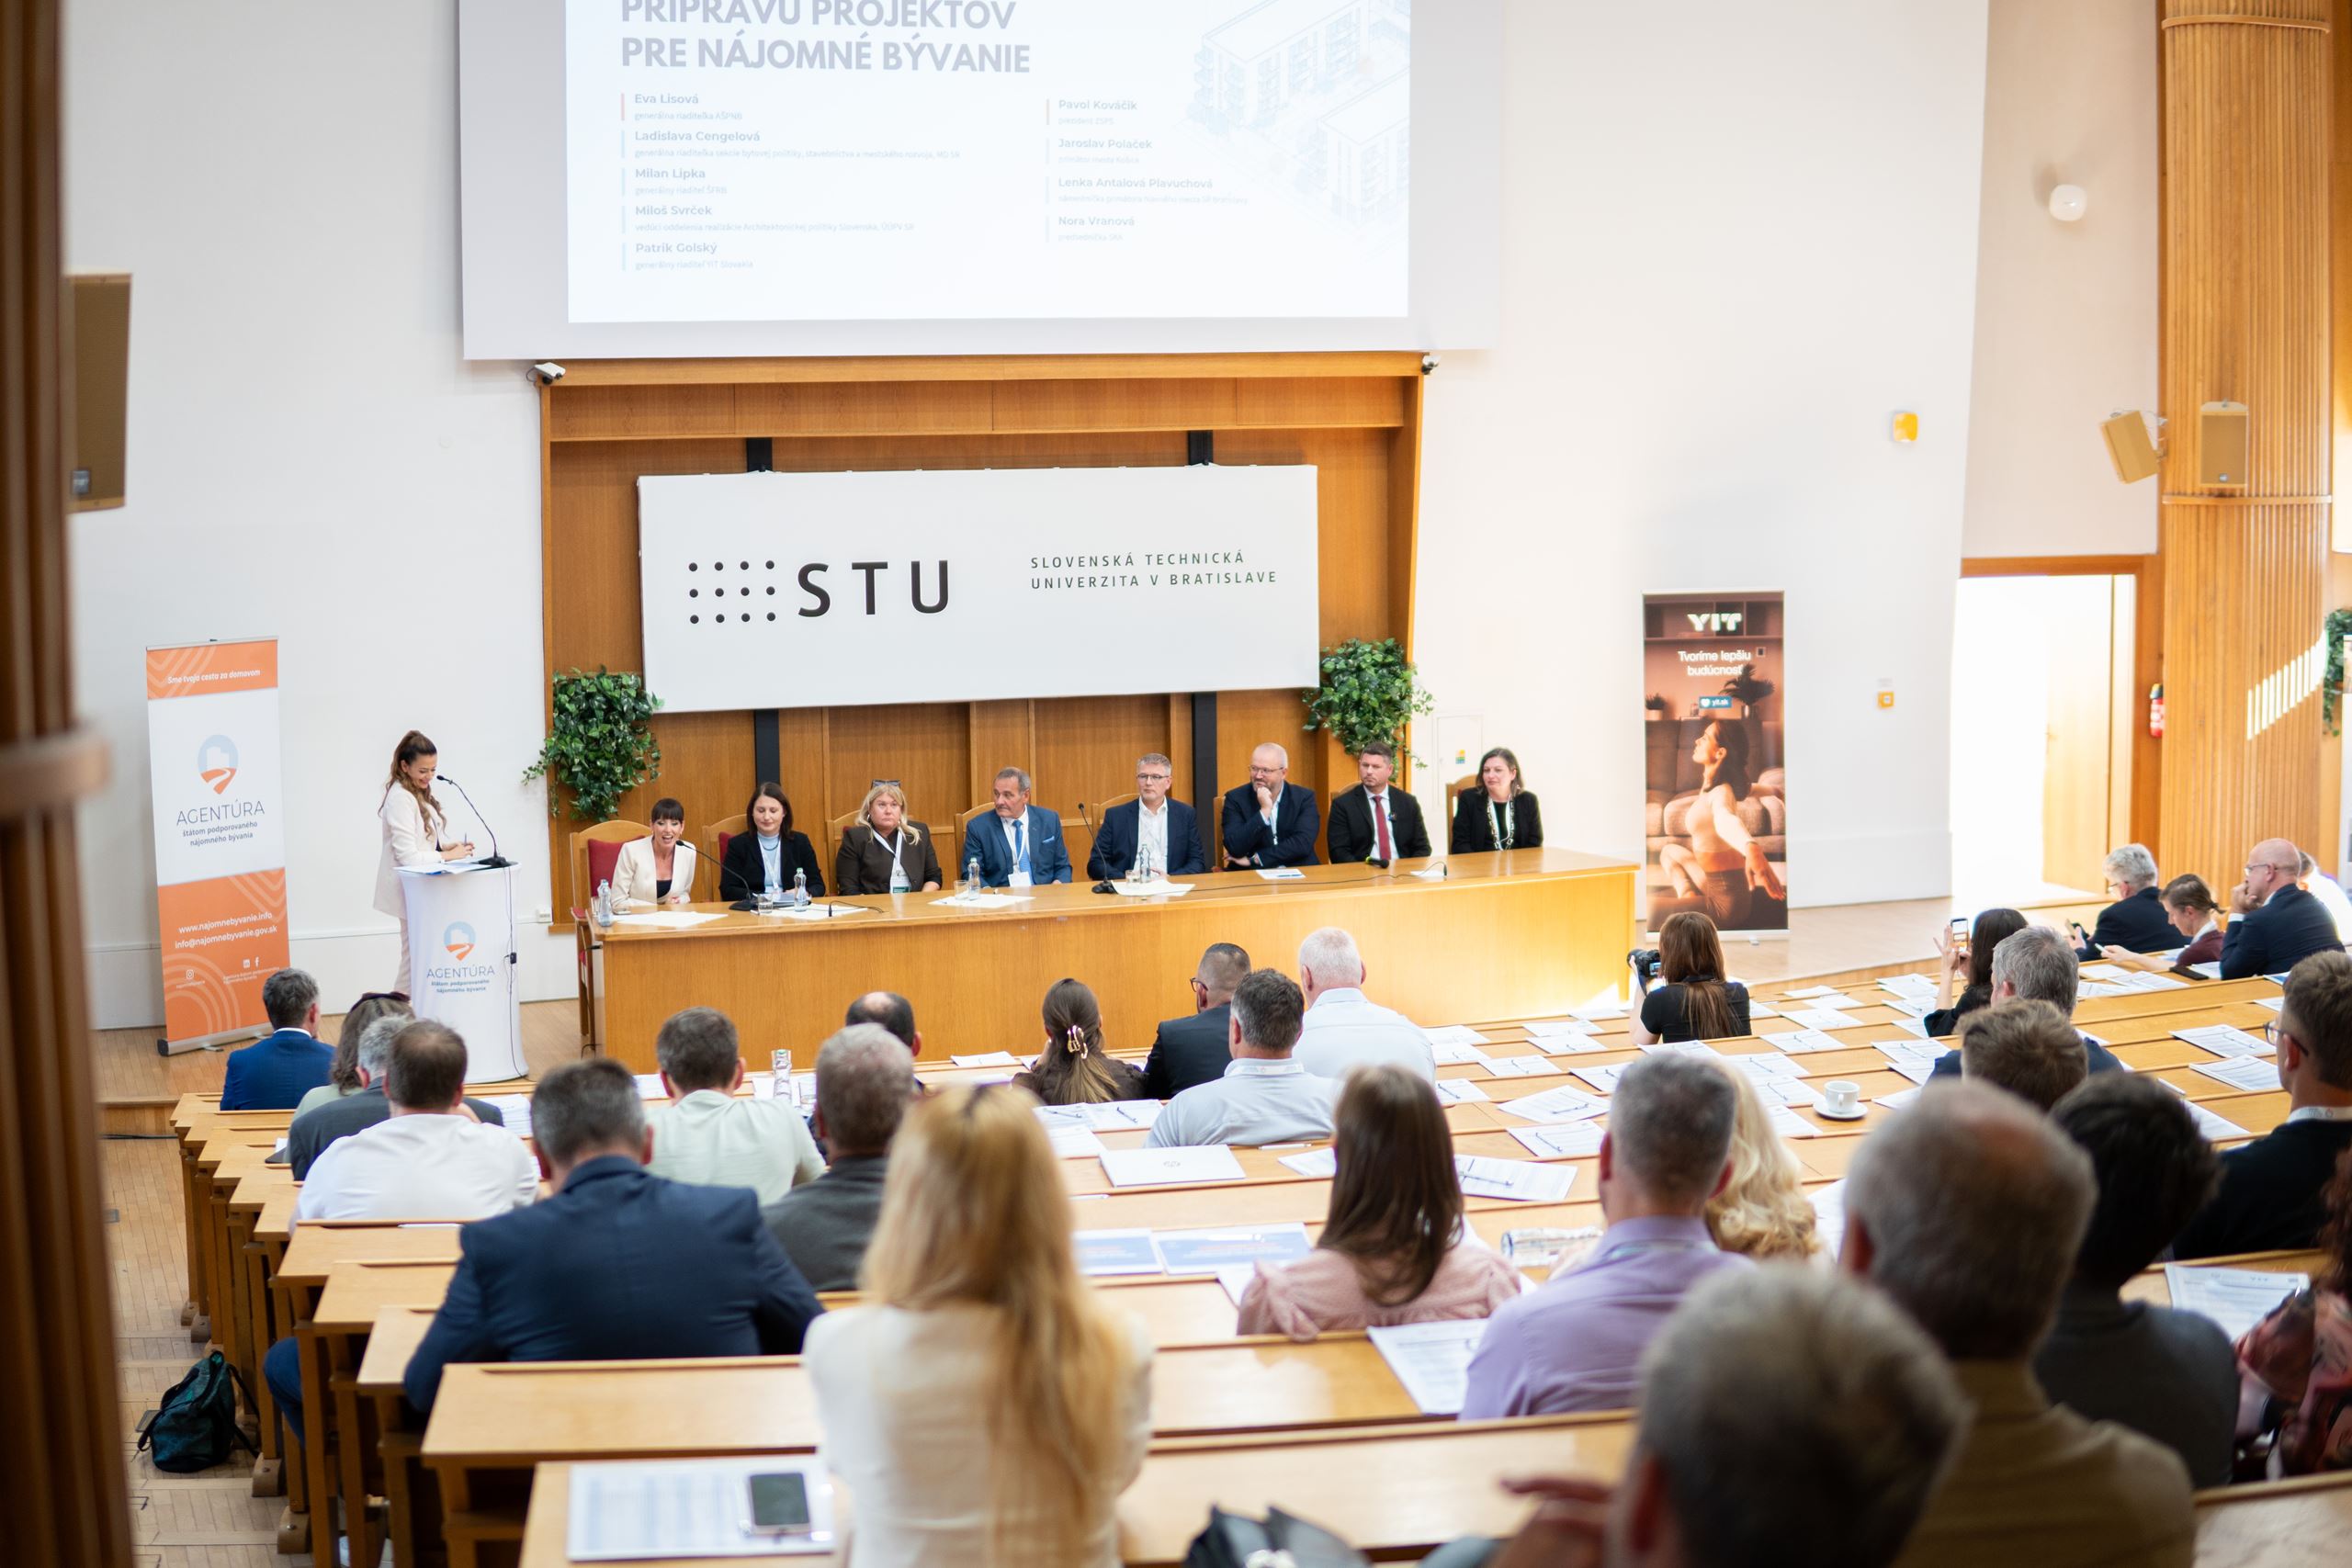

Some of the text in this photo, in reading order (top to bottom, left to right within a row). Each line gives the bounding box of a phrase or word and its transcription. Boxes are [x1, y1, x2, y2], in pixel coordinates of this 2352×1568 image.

[813, 0, 1015, 28] PROJEKTOV
[623, 29, 1029, 73] PRE NÁJOMNÉ BÝVANIE
[635, 94, 698, 103] Eva Lisová
[1058, 100, 1136, 110] Pavol Kováčik
[636, 130, 760, 143] Ladislava Cengelová
[1058, 139, 1104, 148] Jaroslav
[636, 168, 706, 180] Milan Lipka
[1058, 177, 1213, 188] Lenka Antalová Plavuchová
[636, 206, 712, 215] Miloš Svrček
[1058, 217, 1136, 226] Nora Vranová
[636, 243, 717, 254] Patrik Golský
[1031, 549, 1244, 569] SLOVENSKÁ TECHNICKÁ
[1032, 571, 1275, 589] UNIVERZITA V BRATISLAVE
[798, 560, 948, 617] STU
[1687, 613, 1743, 631] YIT
[1678, 650, 1751, 663] Tvoríme lepšiu
[167, 676, 182, 684] Sme
[184, 673, 199, 683] tvoja
[229, 670, 261, 678] domovom
[1687, 664, 1743, 676] budúcnosť
[175, 798, 266, 826] AGENTÚRA
[207, 821, 258, 835] podporovaného
[190, 832, 254, 847] nájomného bývania
[178, 911, 273, 934] www.najomnebyvanie.info
[175, 926, 277, 948] info@najomnebyvanie.gov.sk
[426, 964, 496, 978] AGENTÚRA
